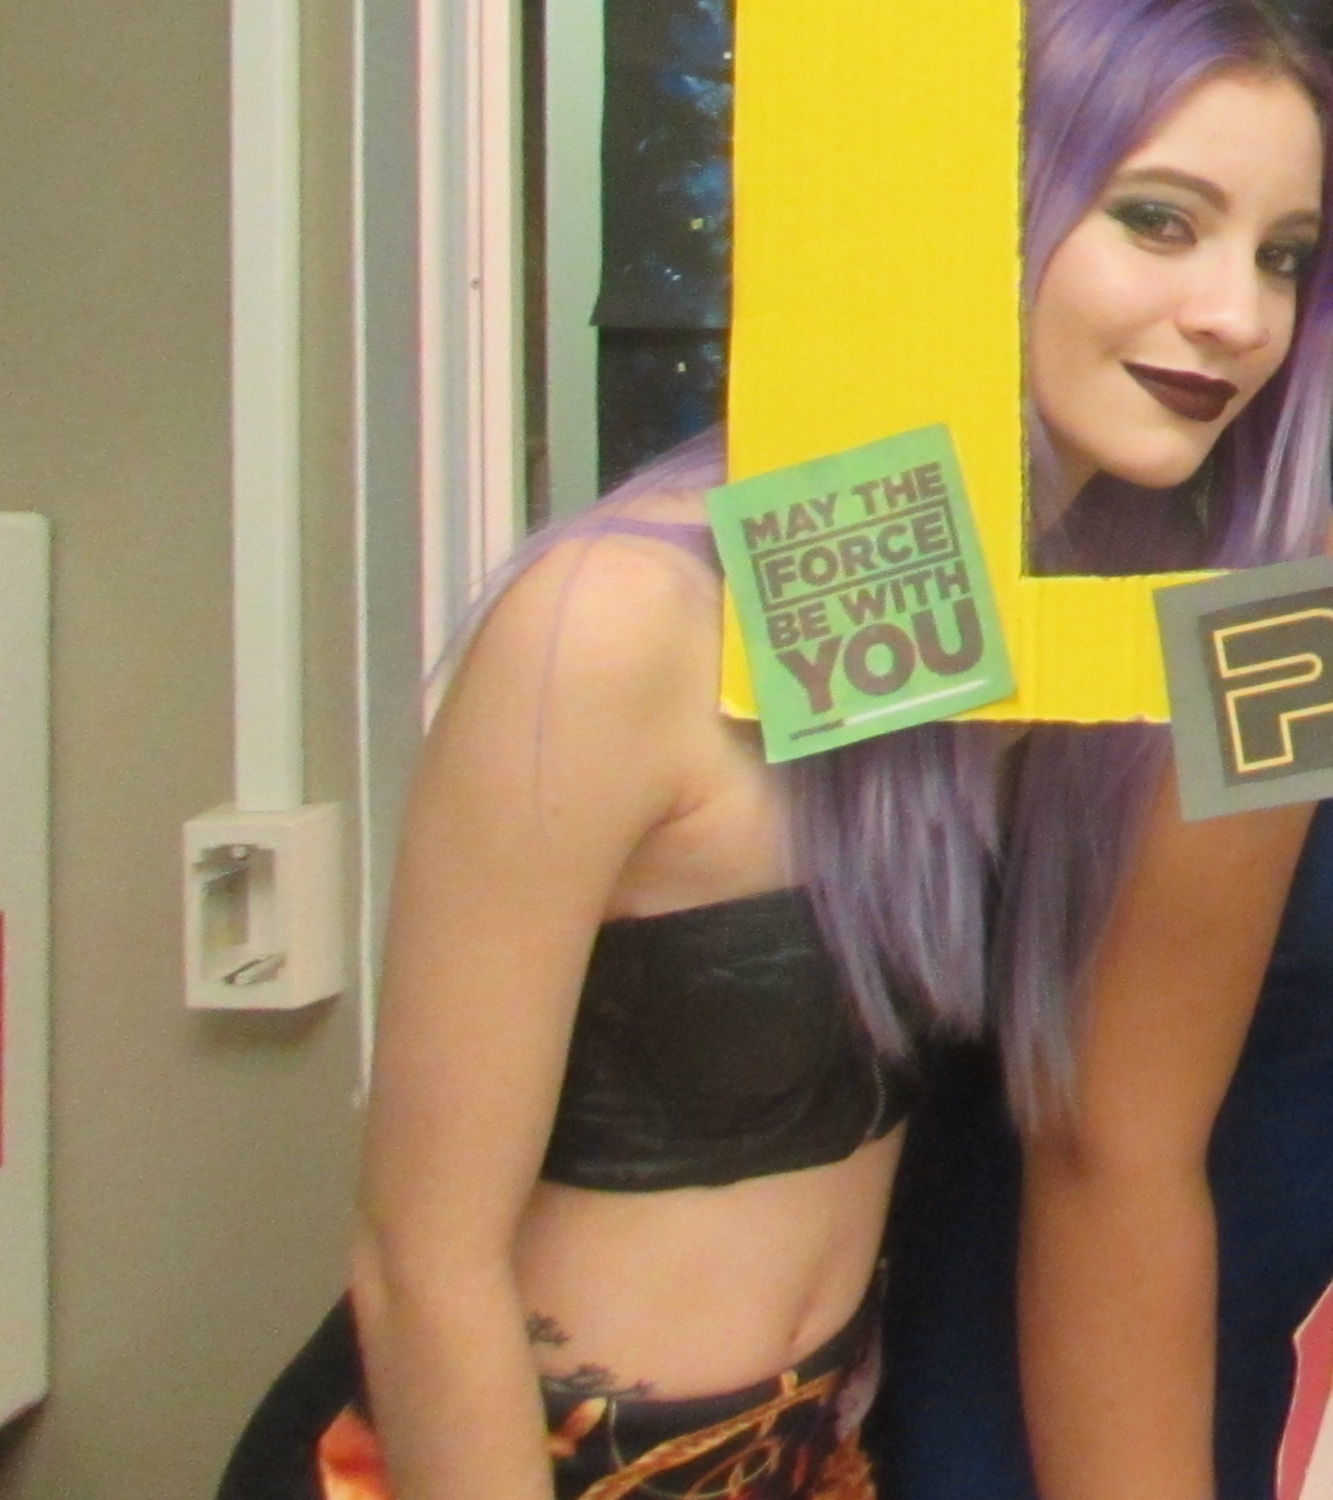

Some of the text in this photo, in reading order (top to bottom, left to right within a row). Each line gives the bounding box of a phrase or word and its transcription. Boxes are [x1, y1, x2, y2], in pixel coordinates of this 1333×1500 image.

[741, 461, 946, 550] MAY THE
[763, 512, 949, 600] FORCE
[766, 560, 971, 650] BE WITH
[776, 596, 984, 715] YOU
